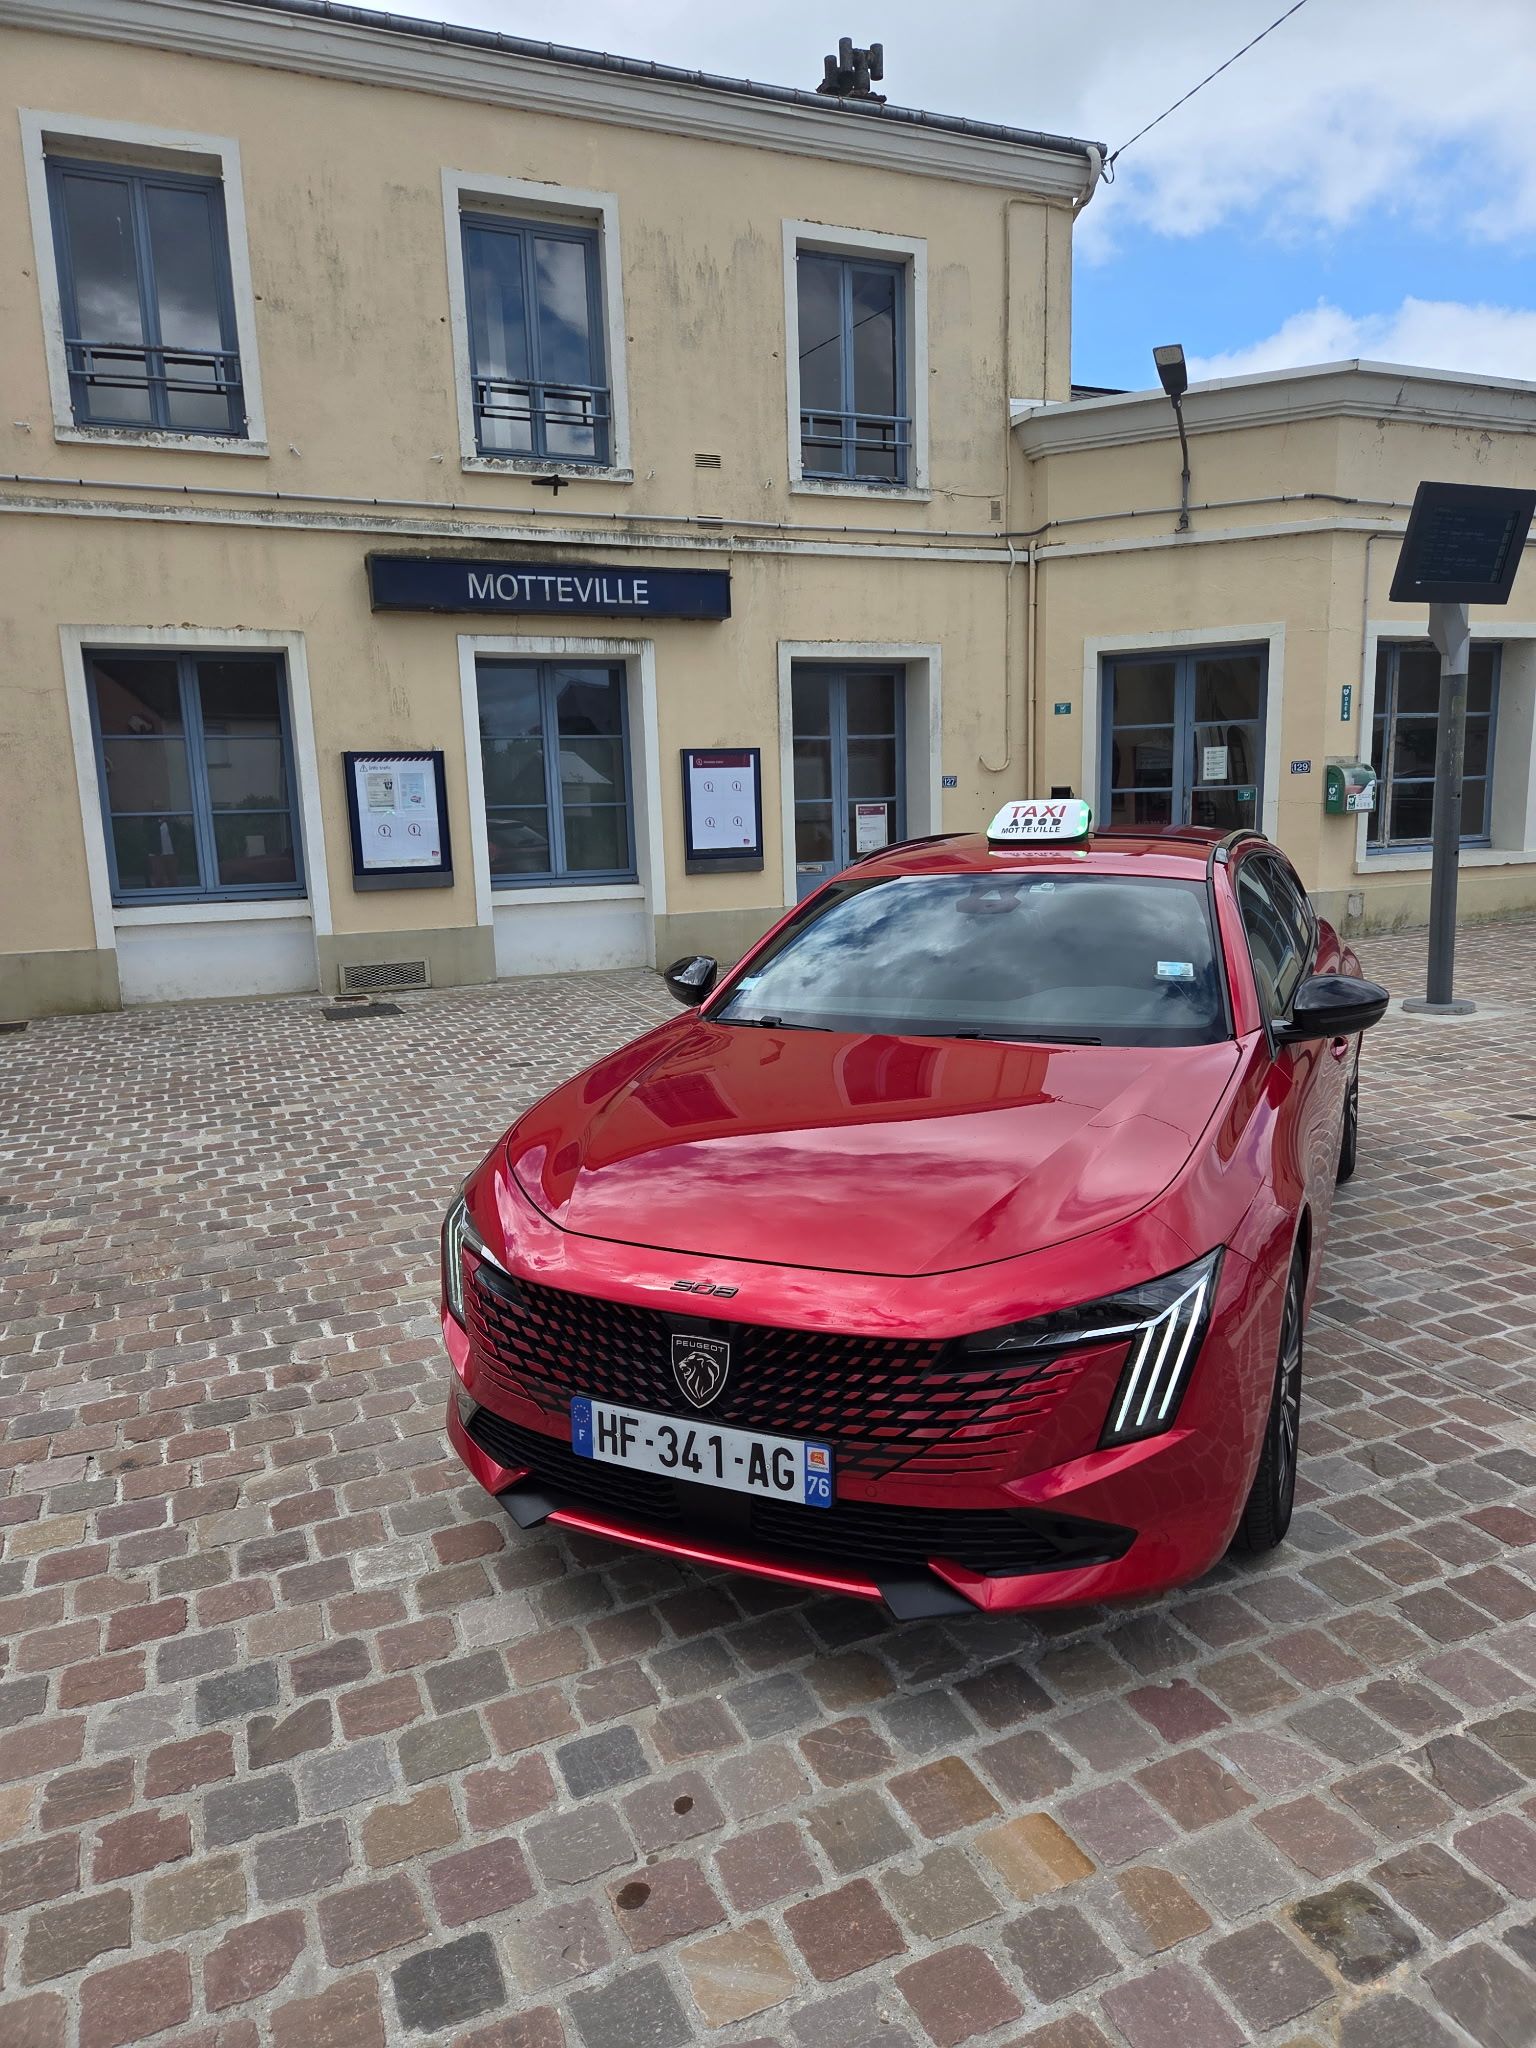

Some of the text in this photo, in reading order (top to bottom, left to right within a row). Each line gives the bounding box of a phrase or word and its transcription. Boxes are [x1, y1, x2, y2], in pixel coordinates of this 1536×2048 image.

[468, 573, 649, 604] MOTTEVILLE
[1294, 763, 1308, 771] 129
[944, 778, 955, 786] 127
[1011, 805, 1067, 818] TAXI
[1001, 826, 1061, 834] MOTTEVILLE
[670, 1281, 739, 1298] 508
[675, 1340, 725, 1353] PEUGEOT
[578, 1429, 586, 1441] F
[598, 1410, 795, 1491] HF-341-AG
[807, 1475, 830, 1497] 76
